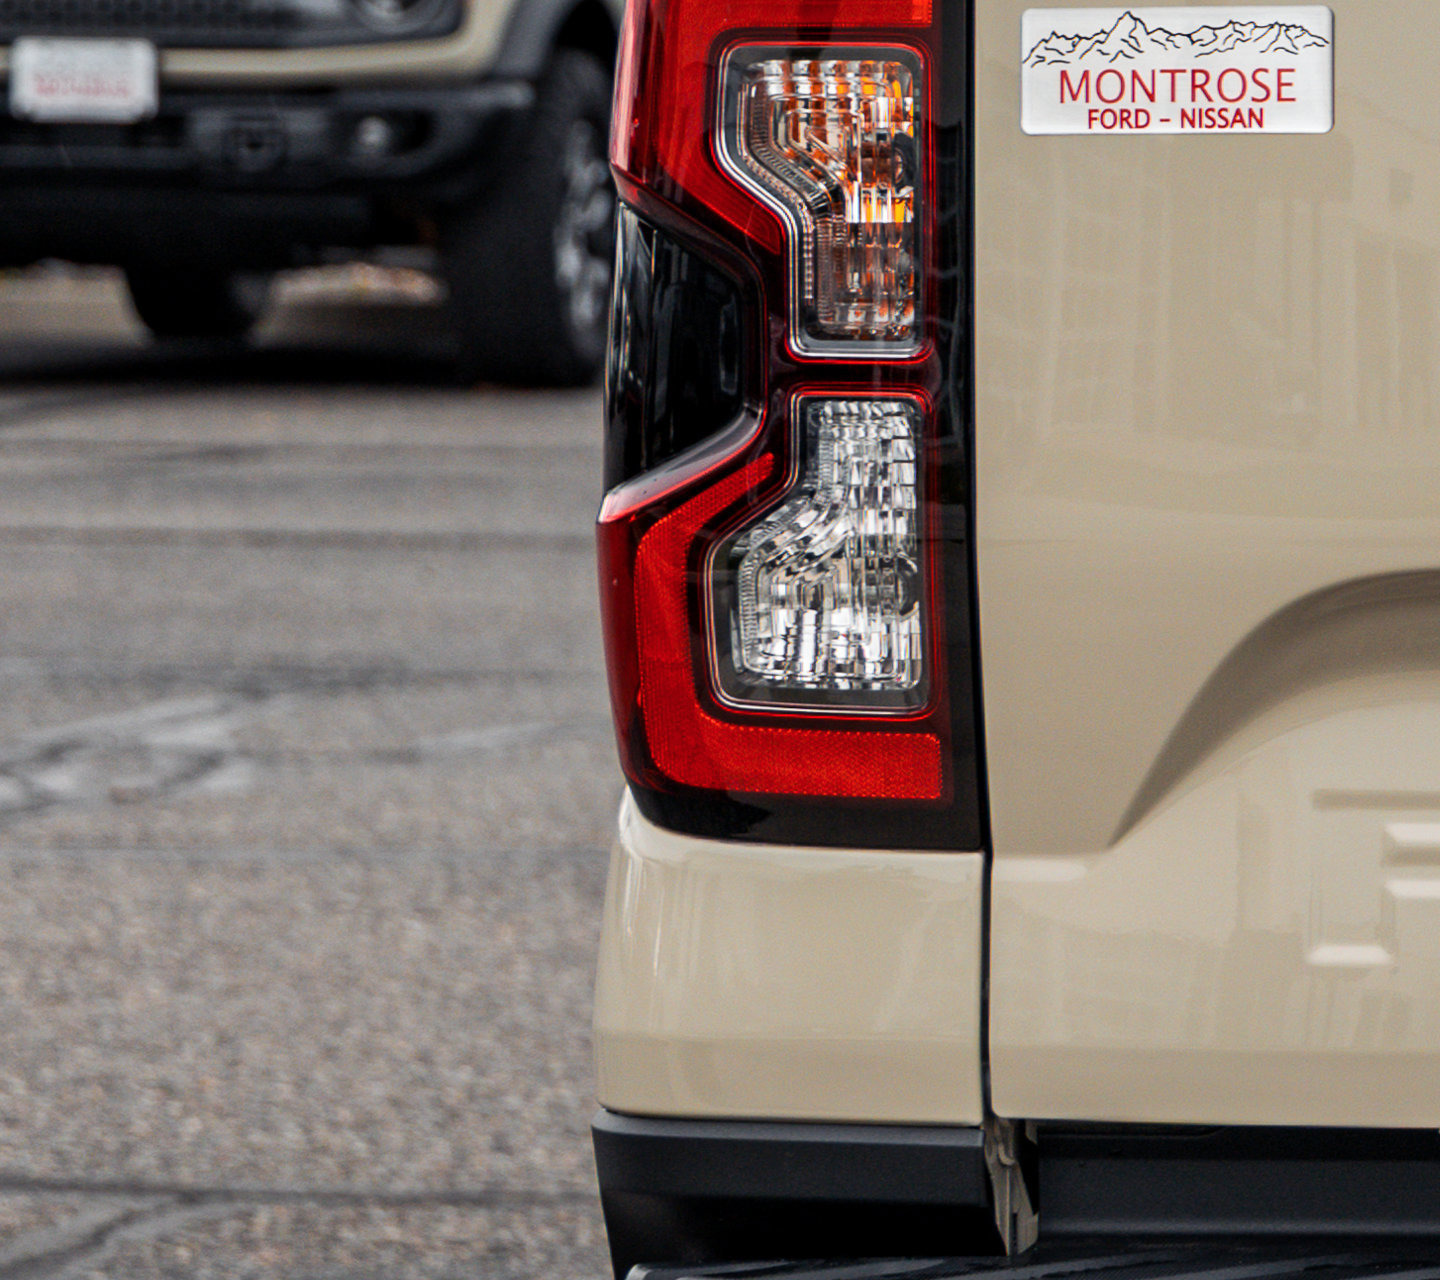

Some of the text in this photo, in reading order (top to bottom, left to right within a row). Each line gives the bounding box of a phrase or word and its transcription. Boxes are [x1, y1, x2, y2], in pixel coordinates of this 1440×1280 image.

[1059, 68, 1297, 104] MONTROSE
[1087, 108, 1151, 130] FORD
[1180, 107, 1264, 129] NISSAN
